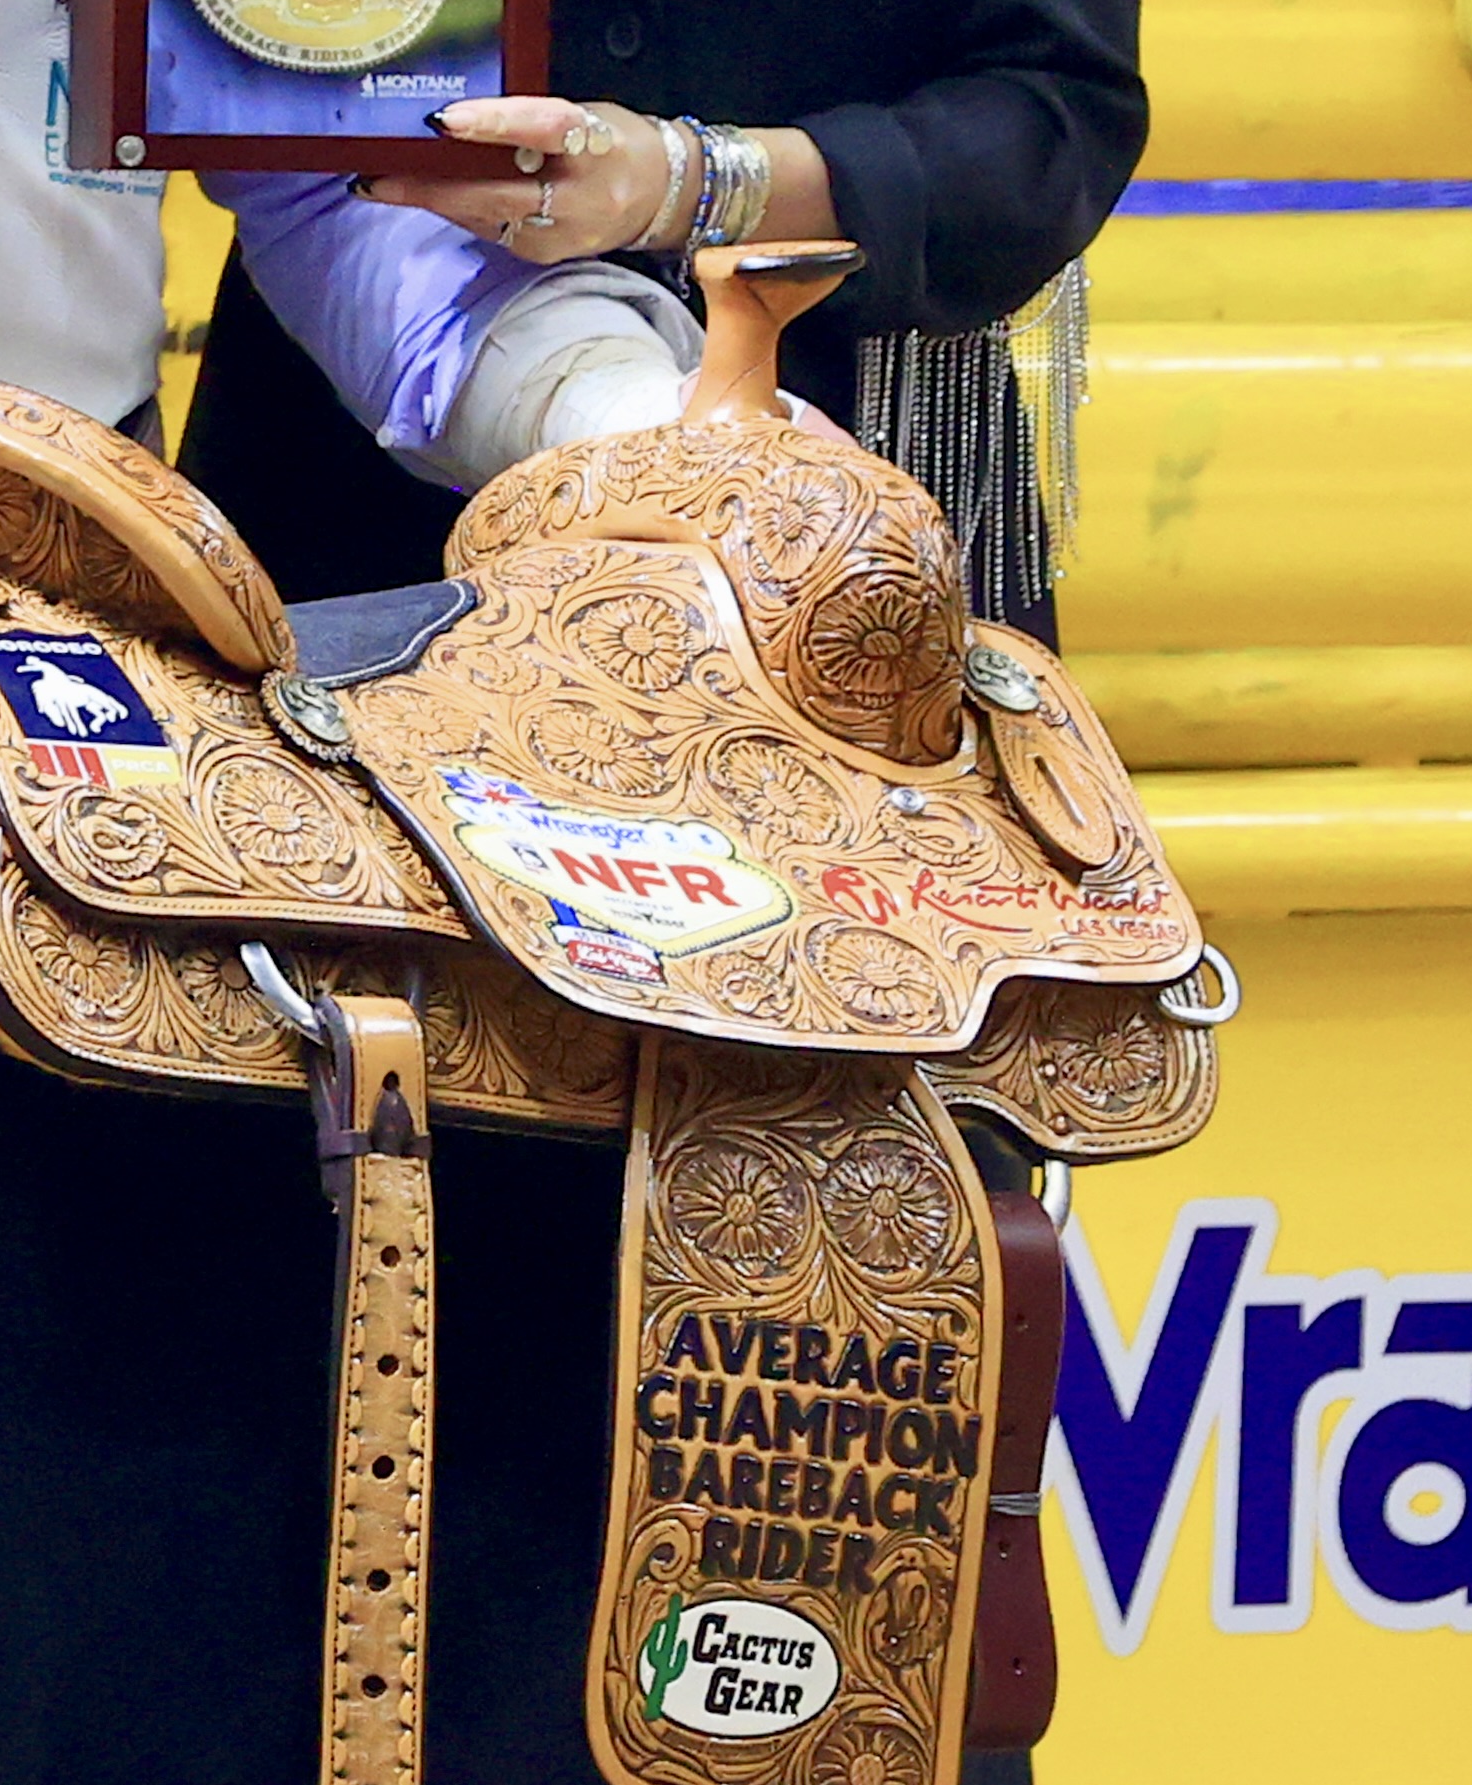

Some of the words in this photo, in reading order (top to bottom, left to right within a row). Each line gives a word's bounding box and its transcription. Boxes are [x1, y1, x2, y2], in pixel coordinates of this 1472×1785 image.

[376, 74, 466, 91] MONTANA
[109, 758, 172, 774] PRCA
[518, 810, 649, 849] Wrangler
[549, 847, 742, 908] NFR
[1062, 918, 1106, 936] LAS
[665, 1313, 959, 1404] AVERAGE
[634, 1374, 980, 1478] CHAMPION
[648, 1445, 957, 1536] BAREBACK
[697, 1515, 876, 1595] RIDER
